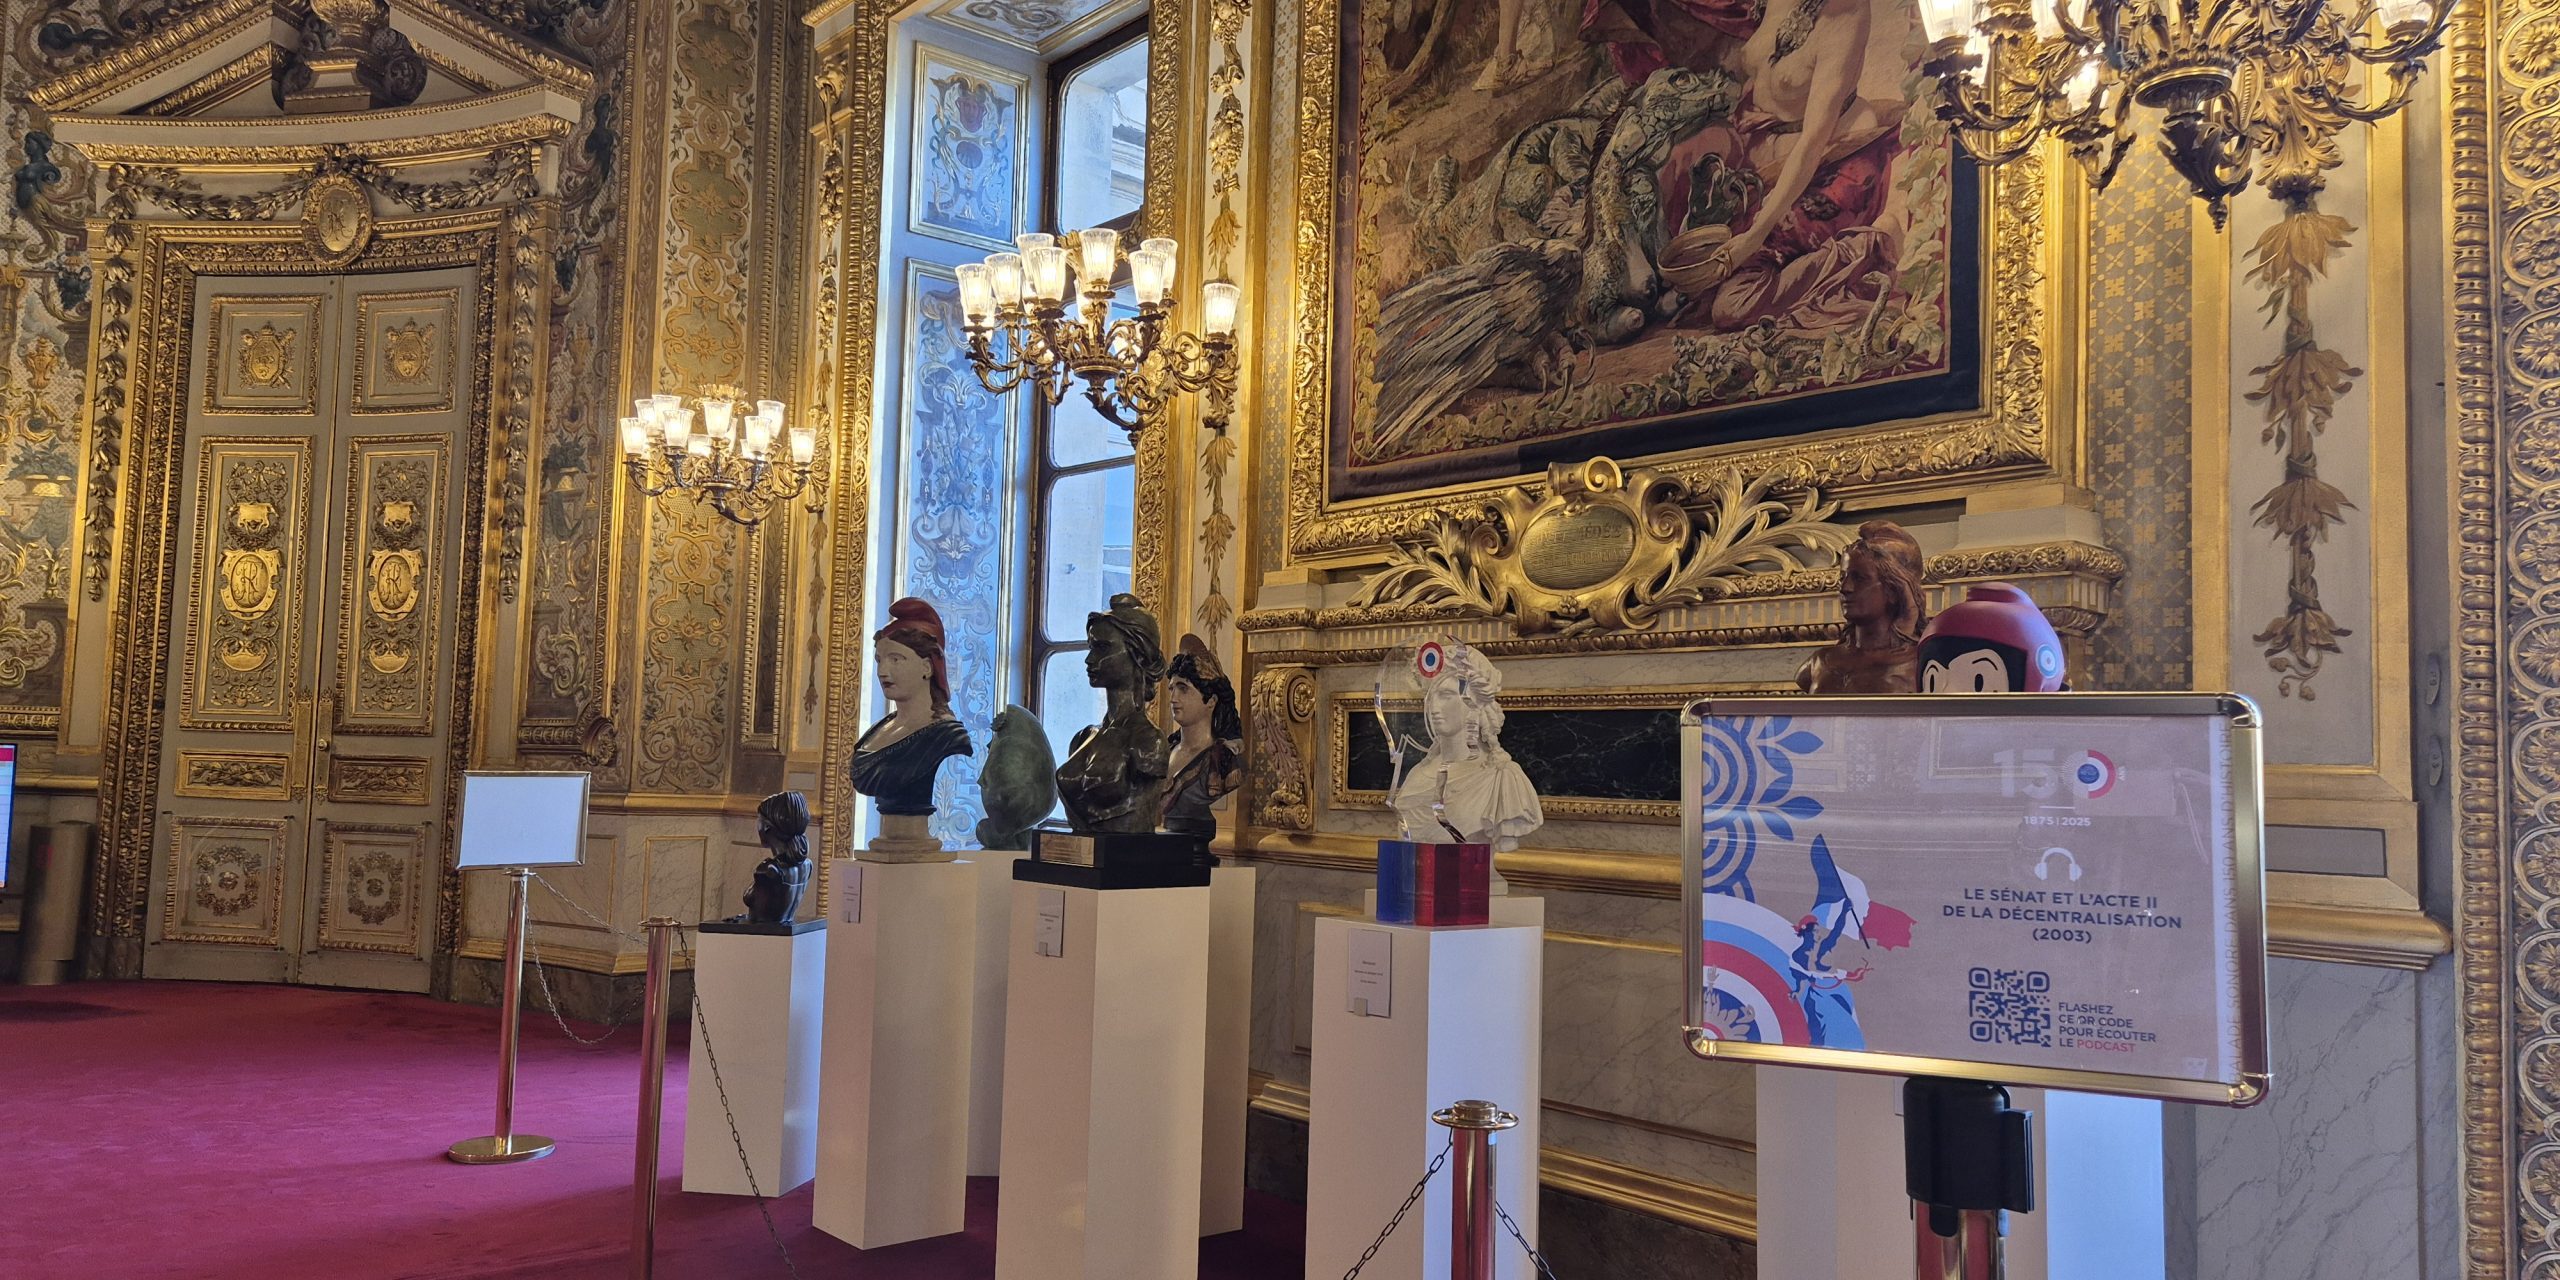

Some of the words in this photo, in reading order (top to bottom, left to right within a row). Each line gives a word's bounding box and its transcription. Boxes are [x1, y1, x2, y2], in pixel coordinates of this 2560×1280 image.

[2221, 817, 2236, 852] ANS
[1963, 888, 1985, 900] LE
[1990, 887, 2047, 903] SÉNAT
[2052, 892, 2074, 905] ET
[2146, 896, 2158, 909] II
[1942, 905, 1966, 917] DE
[1971, 906, 1993, 919] LA
[1999, 906, 2183, 929] DÉCENTRALISATION
[2223, 887, 2239, 933] DANS
[2032, 928, 2093, 944] (2003)
[2058, 1002, 2114, 1015] FLASHEZ
[2058, 1014, 2074, 1024] CE
[2077, 1015, 2096, 1026] QR
[2098, 1017, 2134, 1029] CODE
[2059, 1026, 2094, 1038] POUR
[2097, 1027, 2157, 1043] ÉCOUTER
[2059, 1038, 2074, 1048] LE
[2077, 1038, 2137, 1053] PODCAST
